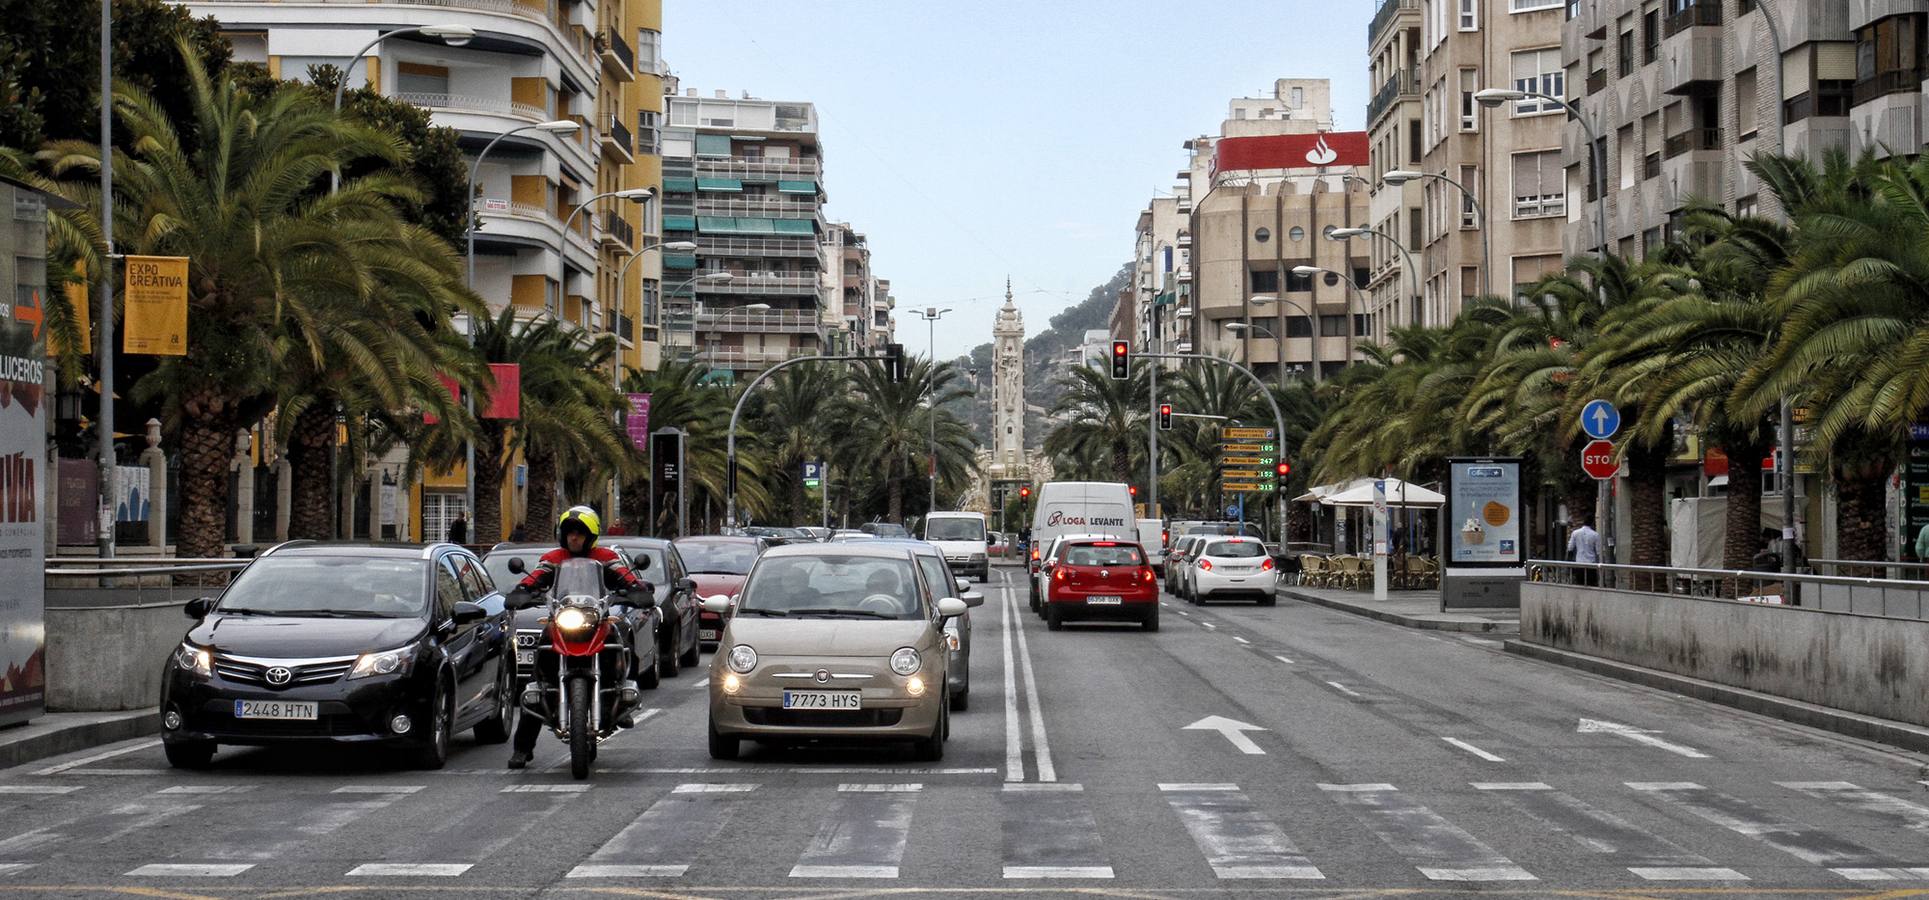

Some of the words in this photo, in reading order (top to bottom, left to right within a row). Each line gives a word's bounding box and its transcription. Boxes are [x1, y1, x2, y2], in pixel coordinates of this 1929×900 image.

[129, 263, 158, 275] EXPO
[129, 275, 183, 288] CREATIVA
[0, 355, 43, 384] LUCEROS
[1910, 426, 1929, 435] CH
[1586, 455, 1610, 465] STO
[806, 464, 816, 477] P
[0, 450, 36, 523] VÍA
[1063, 517, 1086, 525] LOGA
[1090, 517, 1124, 526] LEVANTE
[792, 694, 827, 707] 7773
[832, 694, 858, 707] HYS
[243, 703, 280, 717] 2448
[284, 704, 313, 718] HTN
